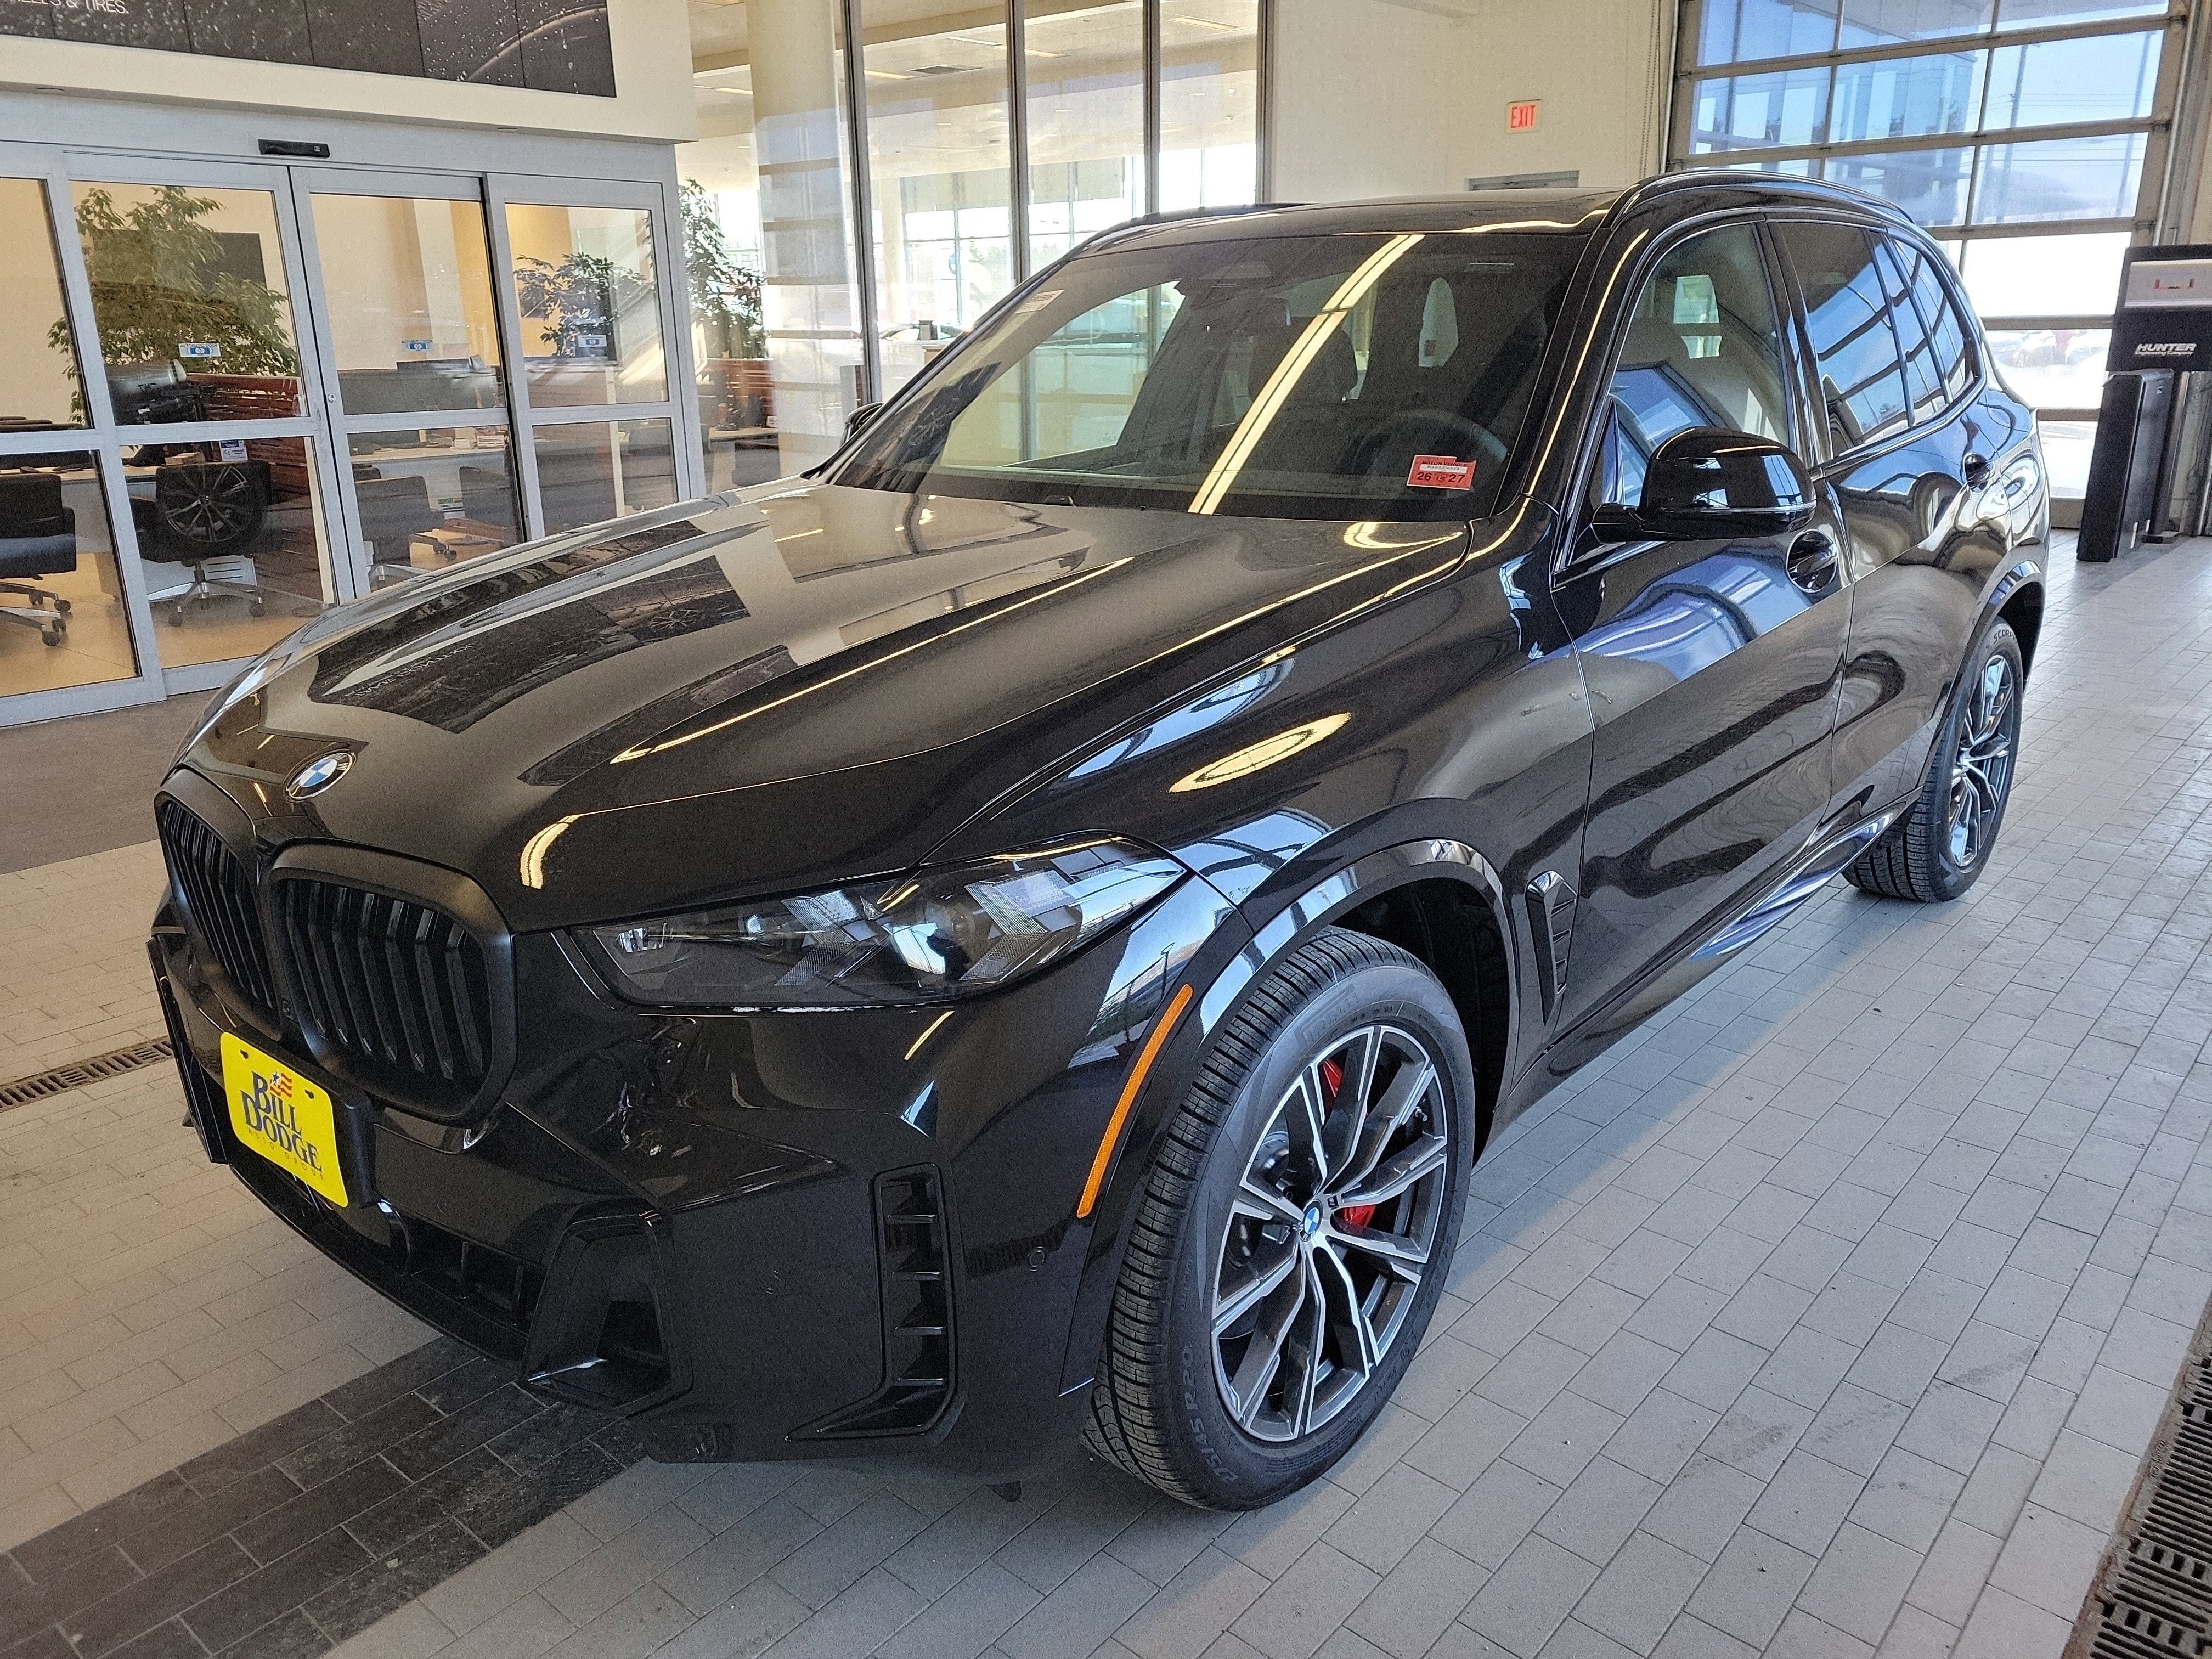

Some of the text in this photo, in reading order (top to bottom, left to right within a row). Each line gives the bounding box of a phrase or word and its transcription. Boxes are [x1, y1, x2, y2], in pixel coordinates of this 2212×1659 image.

[1510, 105, 1536, 128] EXIT
[1417, 472, 1465, 483] 26 27
[239, 1088, 323, 1173] DODGE
[251, 1070, 302, 1137] BILL
[248, 1127, 324, 1180] AUTO GROUP
[1182, 1345, 1199, 1410] R20
